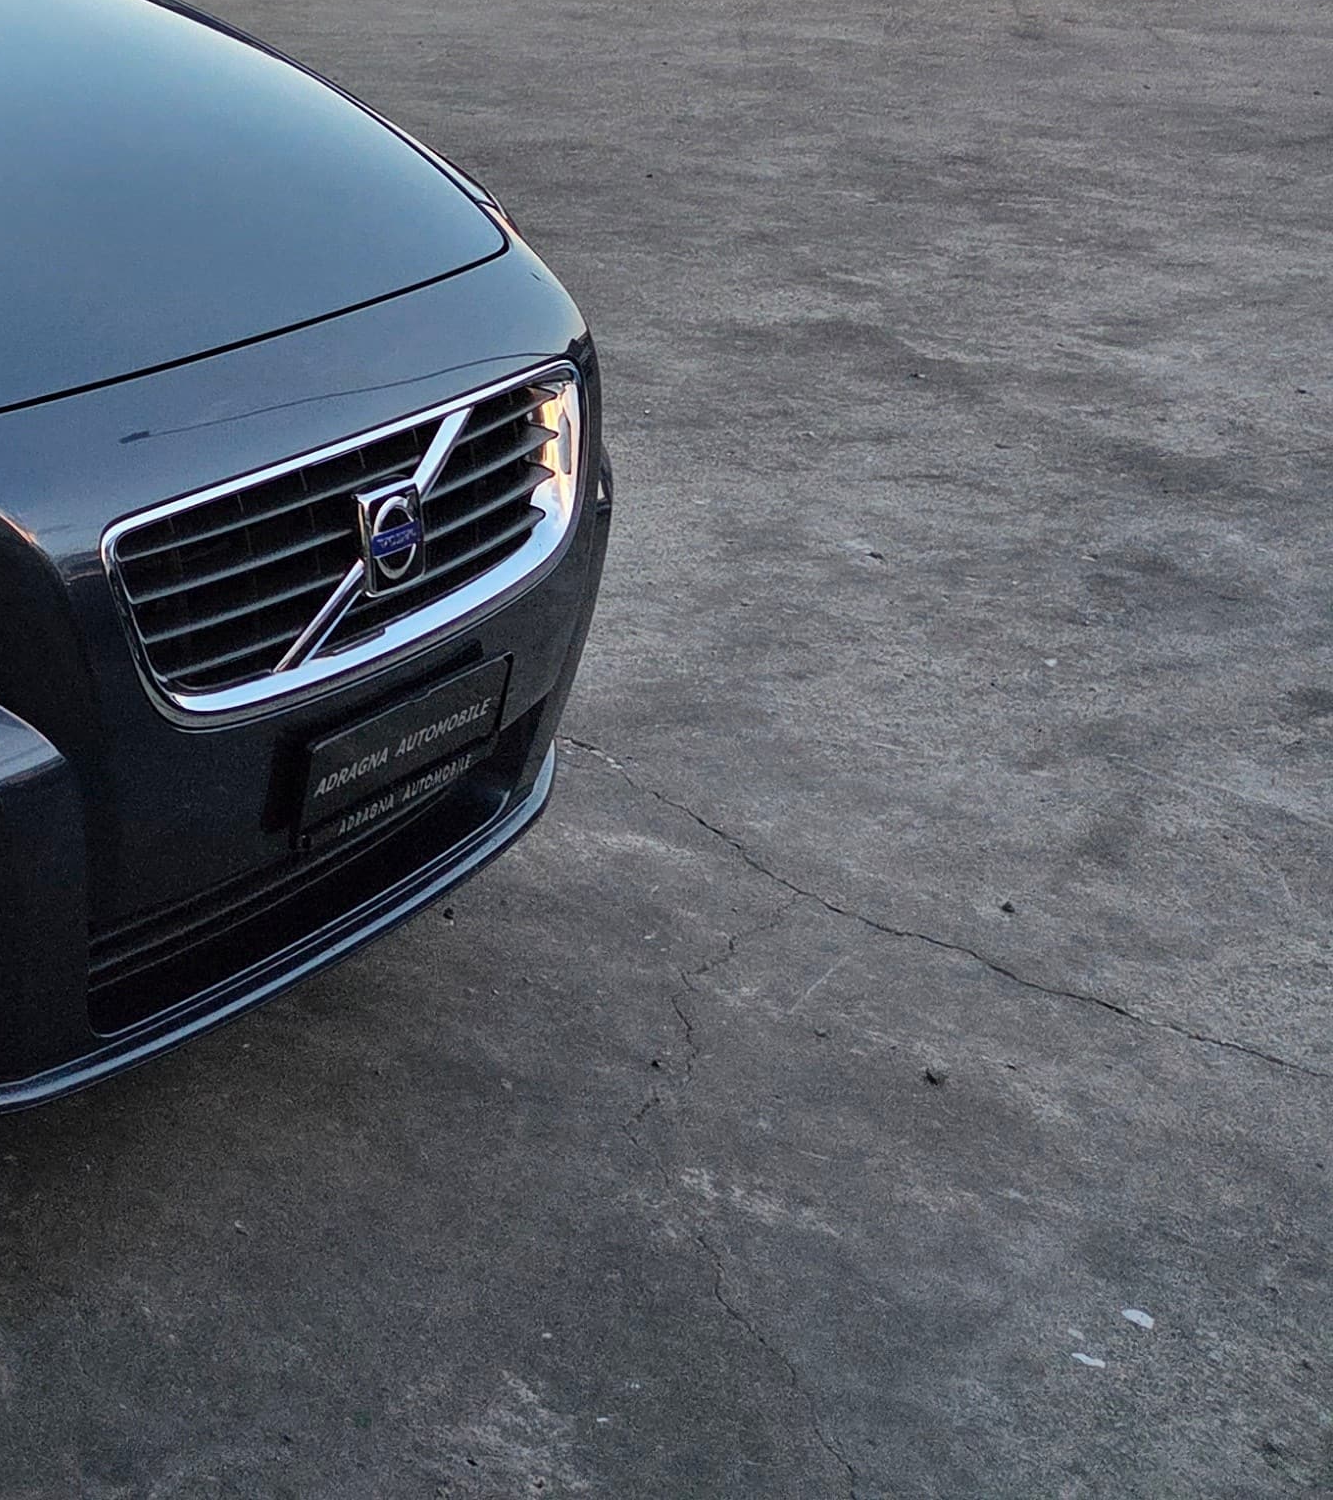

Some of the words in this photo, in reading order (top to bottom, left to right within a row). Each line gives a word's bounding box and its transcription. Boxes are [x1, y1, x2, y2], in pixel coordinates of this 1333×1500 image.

[314, 747, 389, 798] ADRAGNA
[394, 698, 492, 758] AUTOMOBILE
[338, 793, 394, 836] ADRAGNA
[402, 754, 472, 802] AUTOMOBILE
